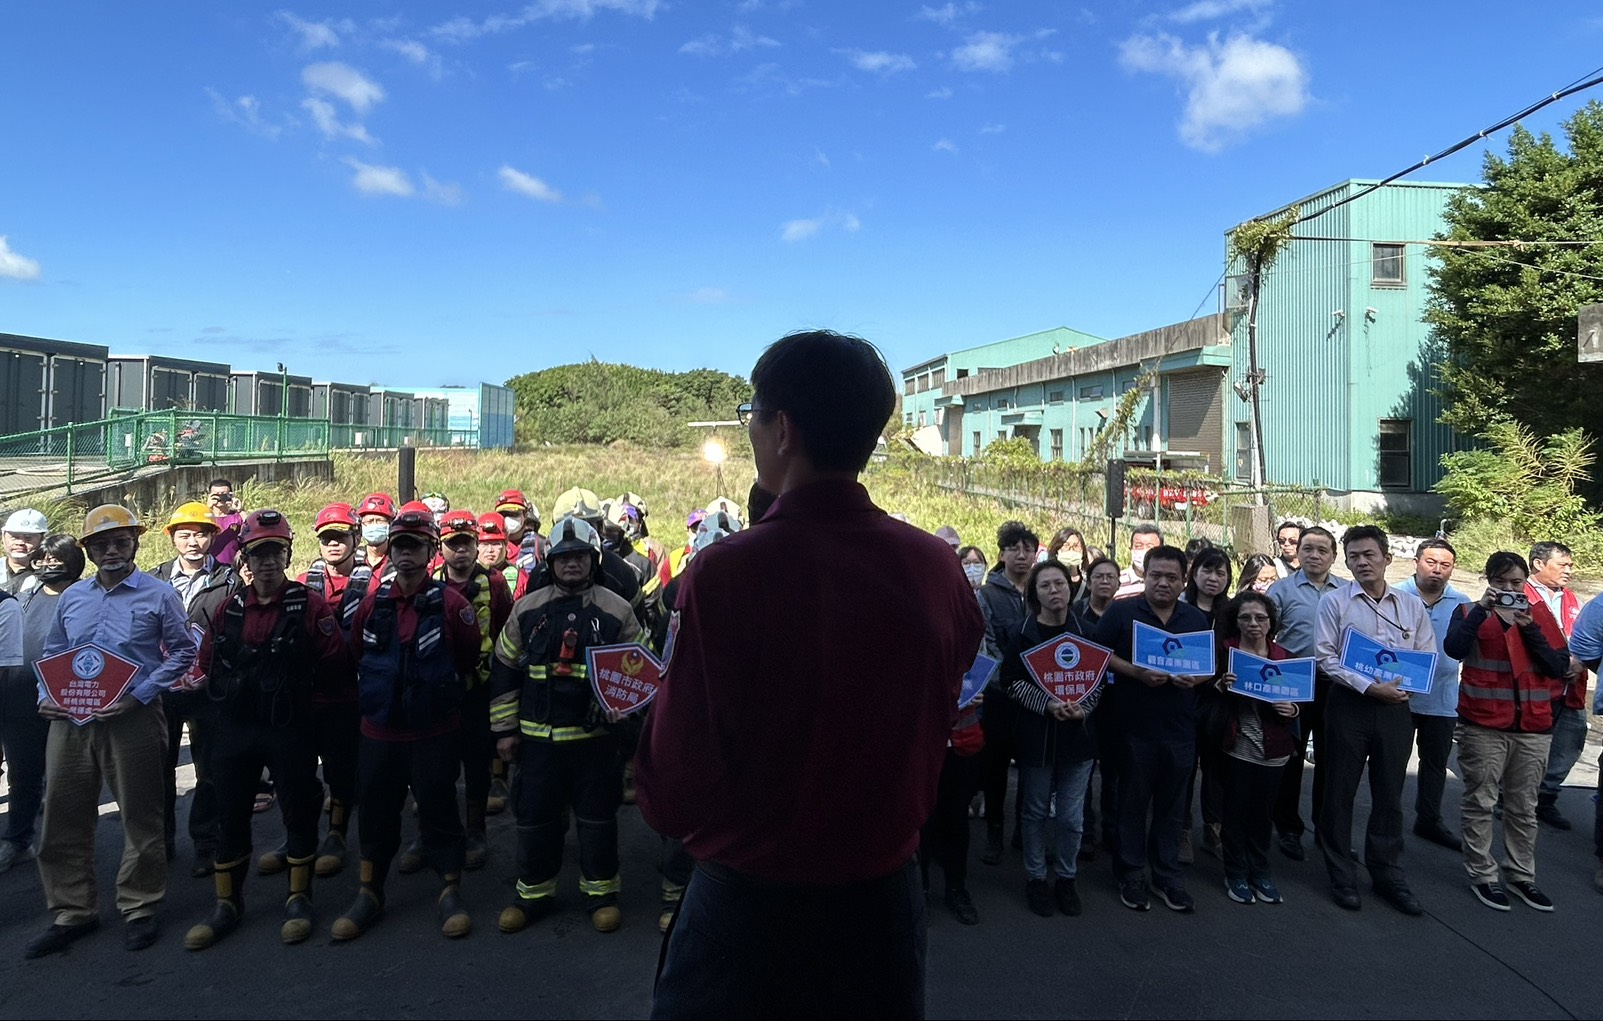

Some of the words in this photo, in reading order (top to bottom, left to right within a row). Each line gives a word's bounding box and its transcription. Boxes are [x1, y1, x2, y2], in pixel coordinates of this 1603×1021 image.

[599, 668, 655, 694] 桃園市政府
[1043, 669, 1096, 683] 桃園市政府
[60, 688, 106, 698] 股份有限公司
[604, 684, 639, 705] 消防局
[1054, 683, 1086, 696] 環保局
